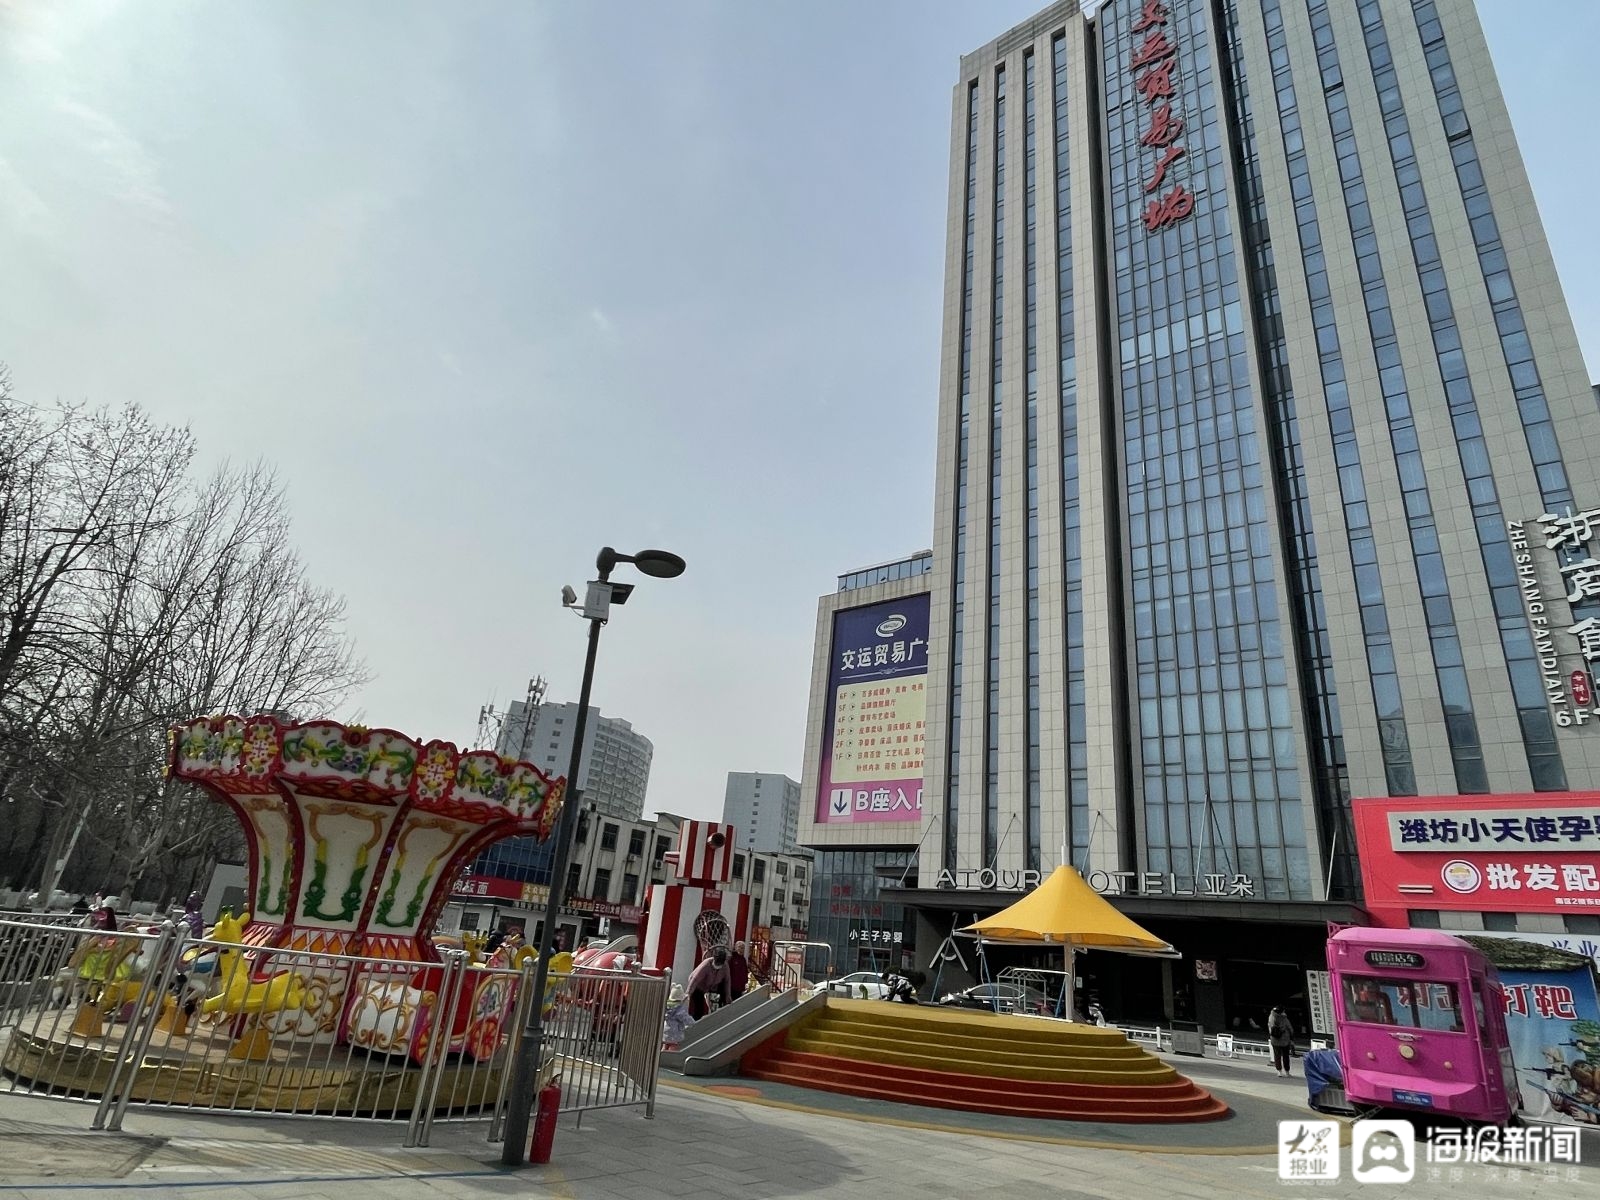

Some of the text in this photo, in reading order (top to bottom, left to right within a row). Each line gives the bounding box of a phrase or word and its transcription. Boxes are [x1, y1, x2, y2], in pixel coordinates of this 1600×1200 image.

[1516, 552, 1544, 614] SHANG
[1533, 616, 1555, 655] FAN
[840, 637, 929, 671] 交运贸易广
[1542, 657, 1566, 706] DIAN
[1556, 708, 1589, 727] 6F
[936, 868, 1255, 897] ATOUR OTEL 亚朵
[1486, 863, 1600, 892] 批发配
[849, 928, 903, 944] 小王子孕婴
